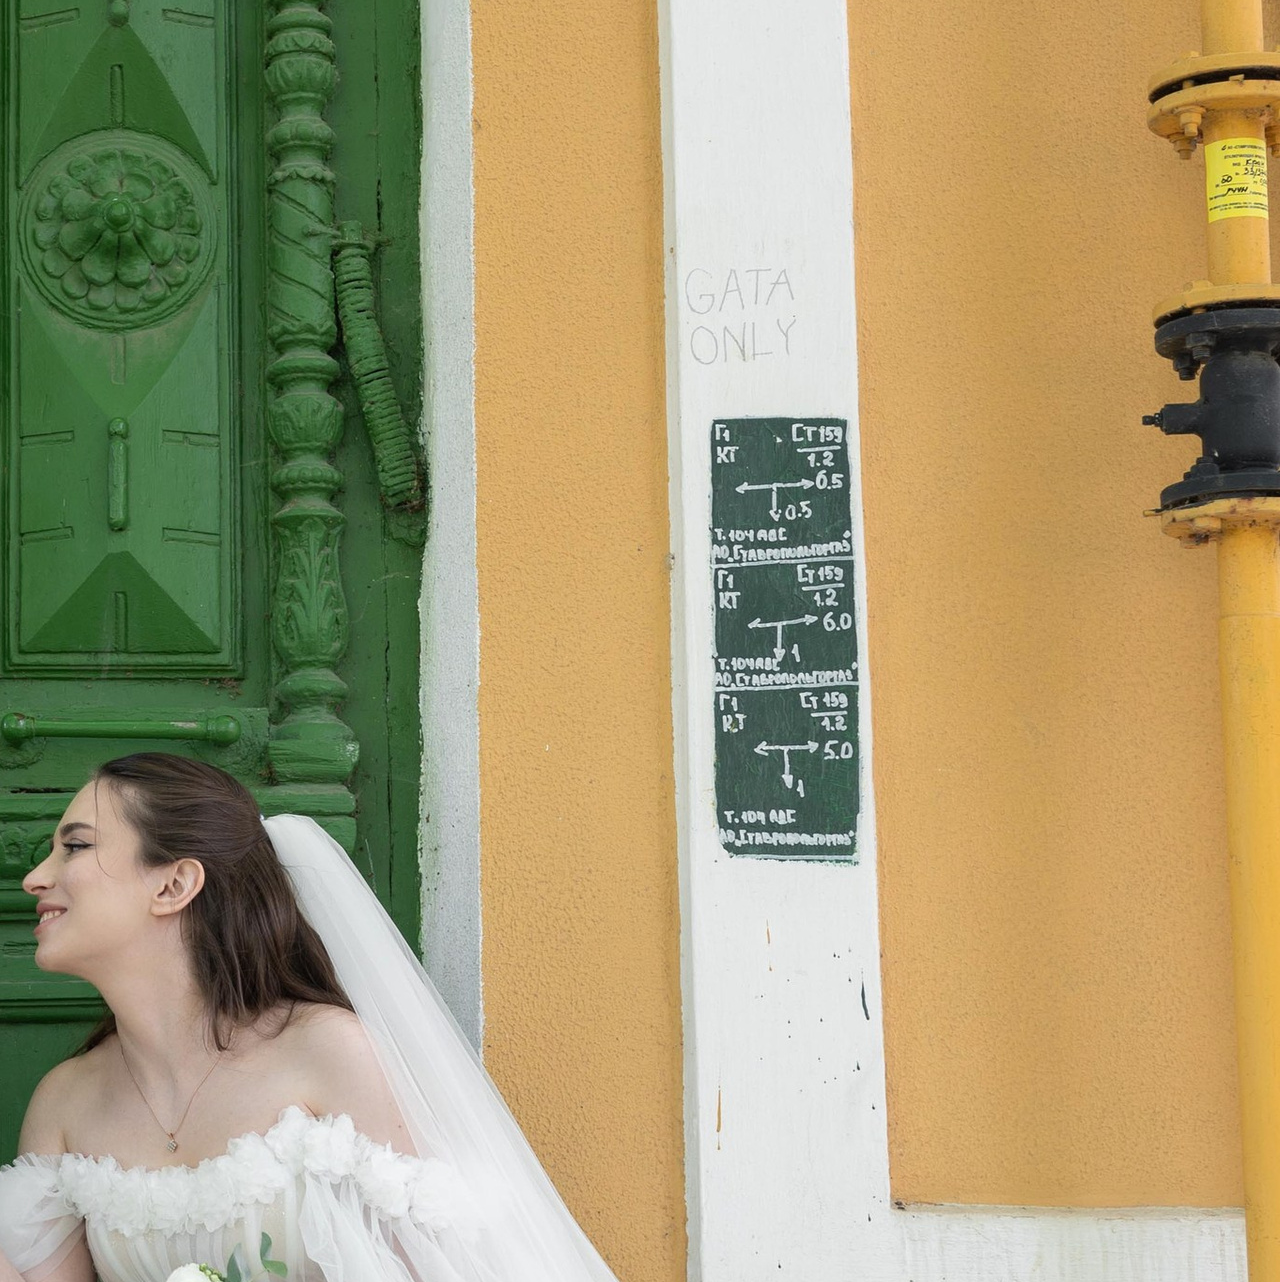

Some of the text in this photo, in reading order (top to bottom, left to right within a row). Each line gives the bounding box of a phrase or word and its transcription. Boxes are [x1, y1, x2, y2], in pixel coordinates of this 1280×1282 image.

[685, 268, 795, 314] GATA
[690, 318, 797, 365] ONLY
[818, 426, 843, 443] 159
[807, 451, 834, 467] 1.2
[815, 469, 844, 490] 6.5
[818, 565, 844, 581] 159
[814, 588, 838, 607] 1.2
[822, 611, 852, 631] 6.0
[791, 643, 800, 662] 1
[822, 692, 849, 708] 159
[821, 715, 848, 731] 1.2
[823, 740, 853, 760] 5.0
[796, 779, 805, 798] 1
